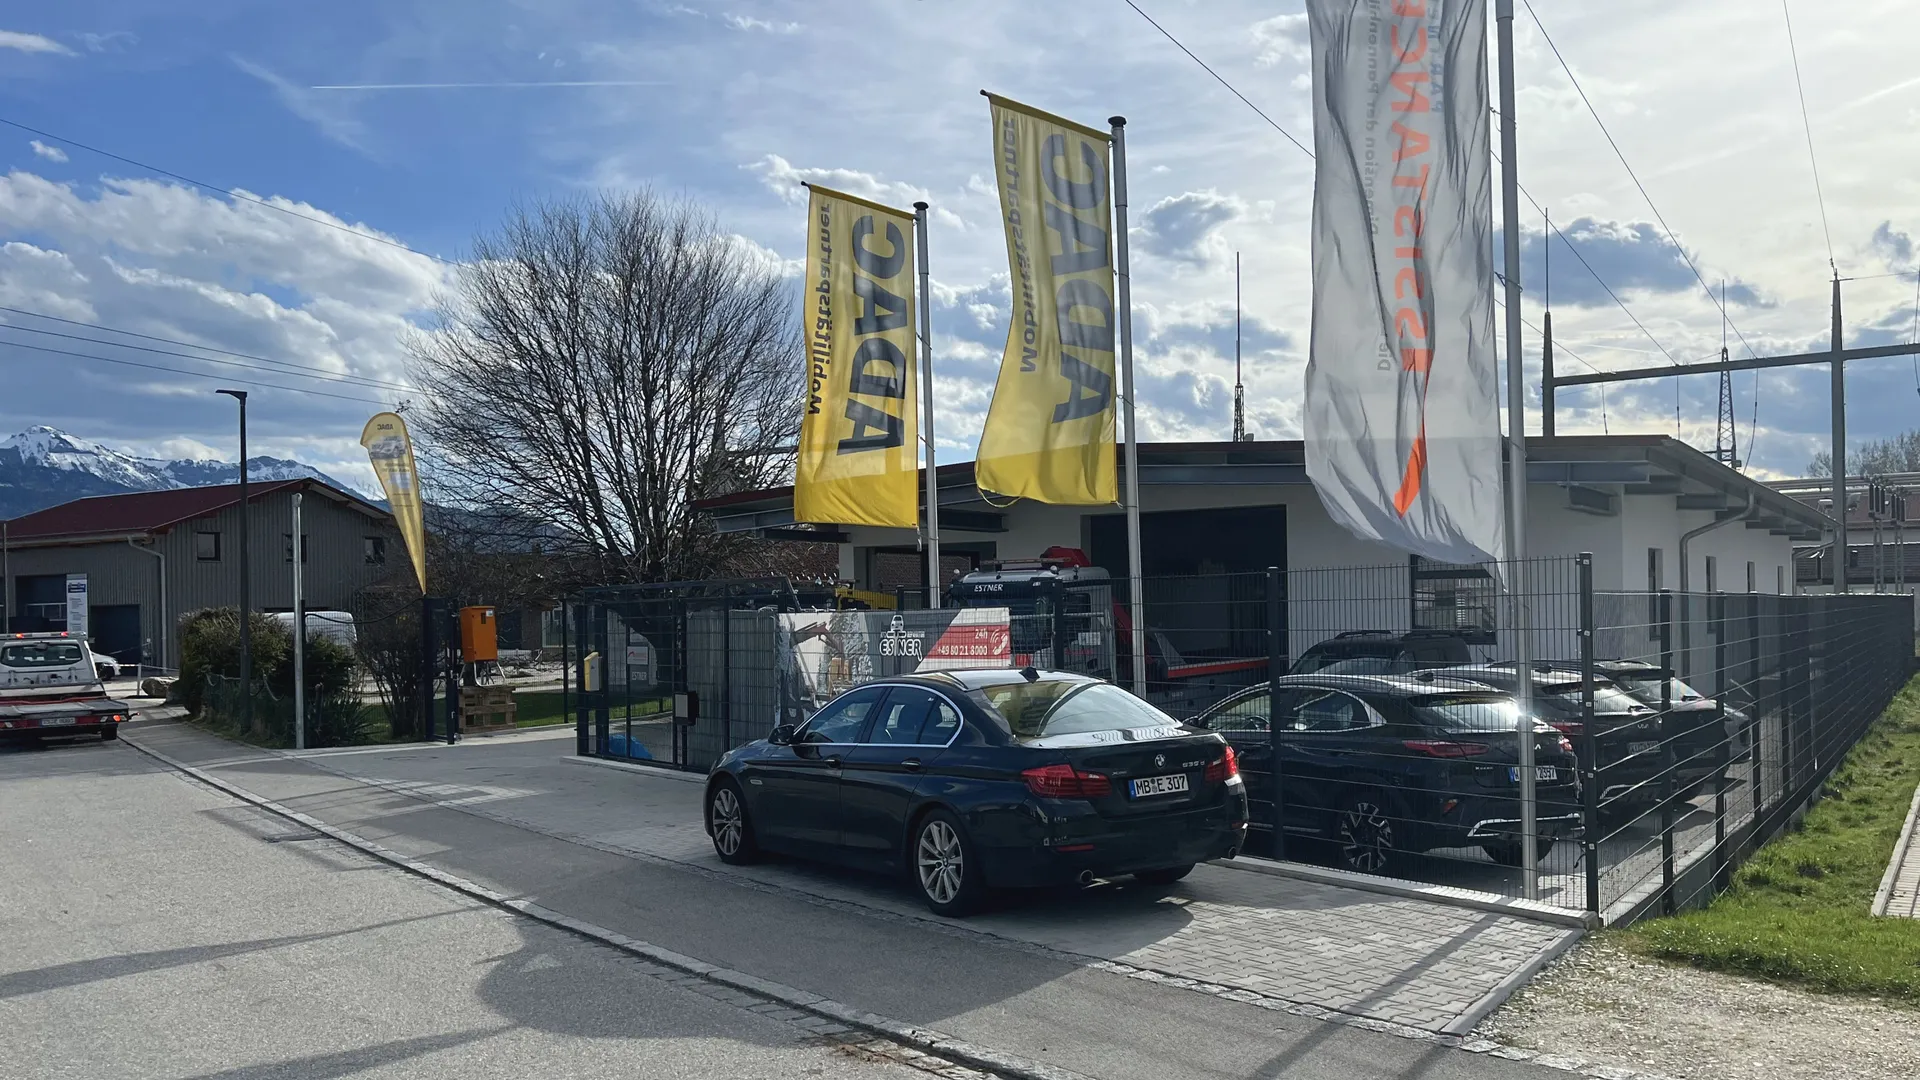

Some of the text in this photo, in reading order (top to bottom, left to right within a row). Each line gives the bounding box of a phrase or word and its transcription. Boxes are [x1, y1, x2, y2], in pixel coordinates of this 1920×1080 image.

[974, 584, 1004, 592] ESTNER
[975, 628, 988, 639] 24h
[880, 635, 922, 661] ESTNER
[960, 646, 969, 656] 21
[1136, 776, 1185, 795] MB E 307
